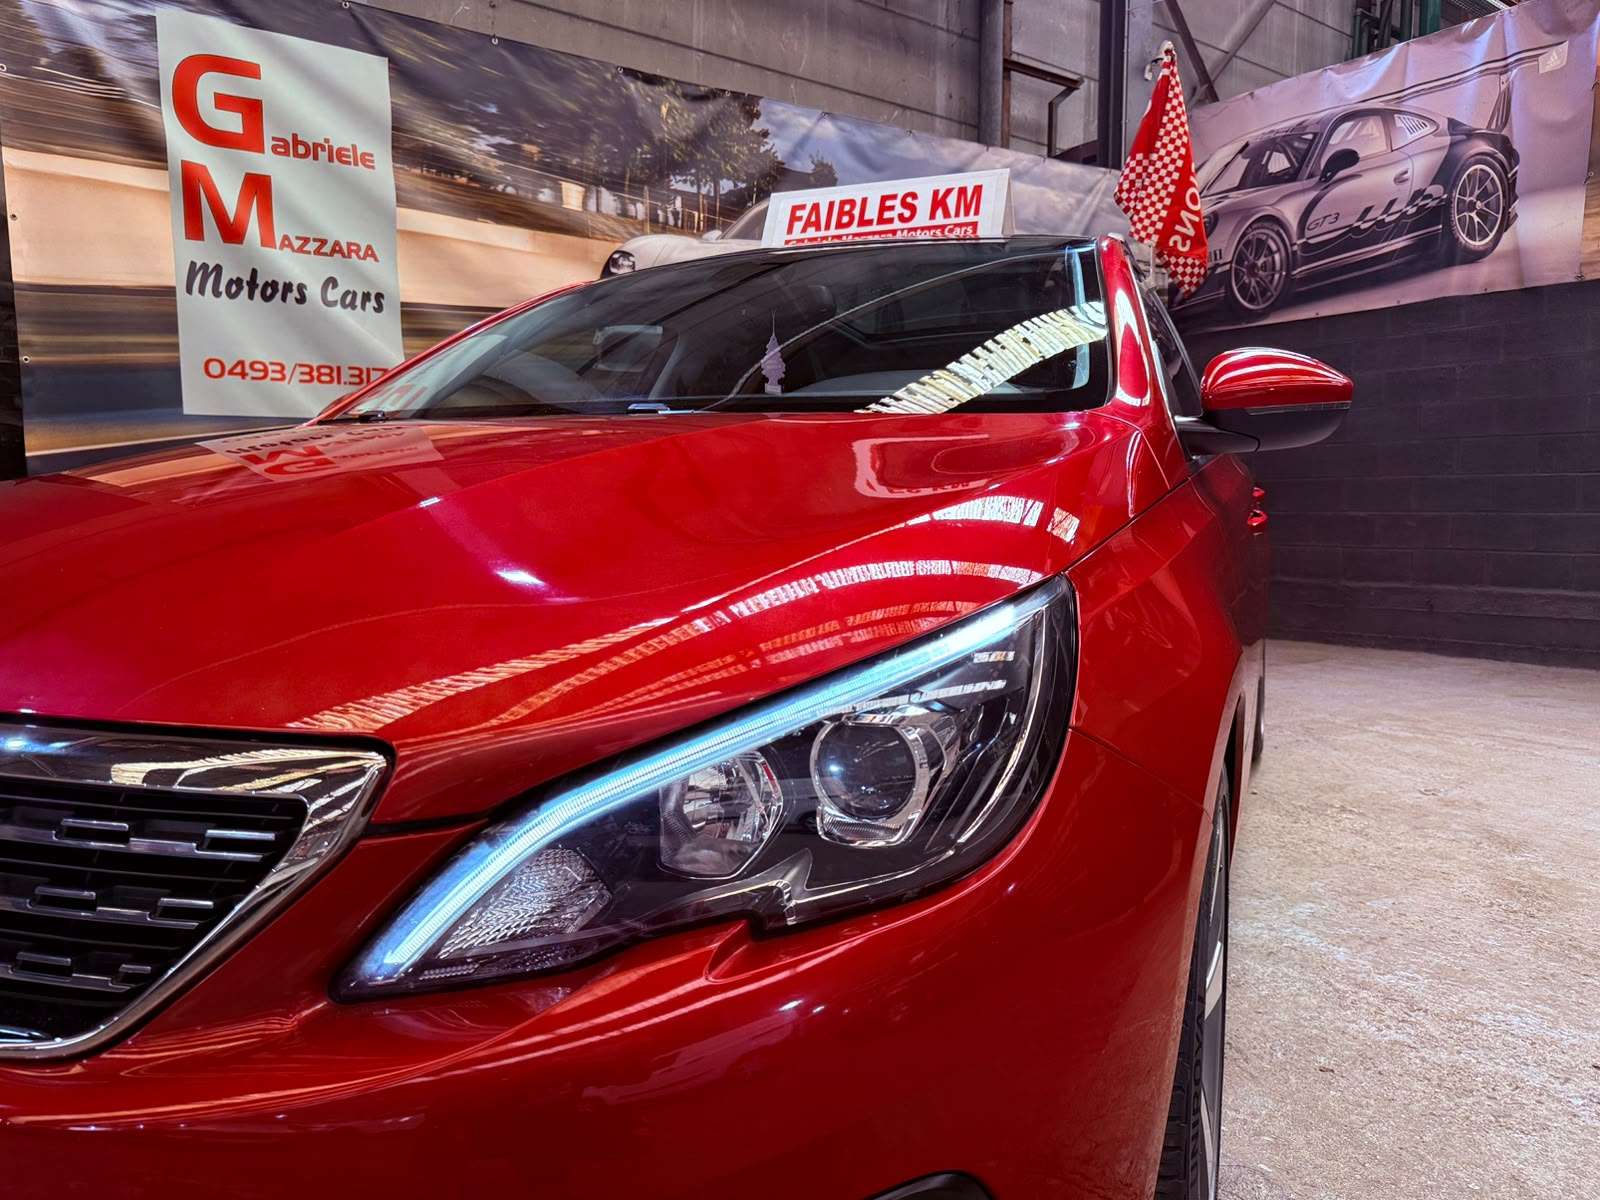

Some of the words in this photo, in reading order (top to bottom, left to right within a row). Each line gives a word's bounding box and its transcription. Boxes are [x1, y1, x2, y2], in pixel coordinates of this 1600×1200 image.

[787, 192, 918, 235] FAIBLES
[929, 185, 983, 220] KM
[1307, 212, 1340, 231] GT3
[944, 225, 974, 236] Cars
[185, 260, 308, 305] Motors
[320, 276, 385, 314] Cars
